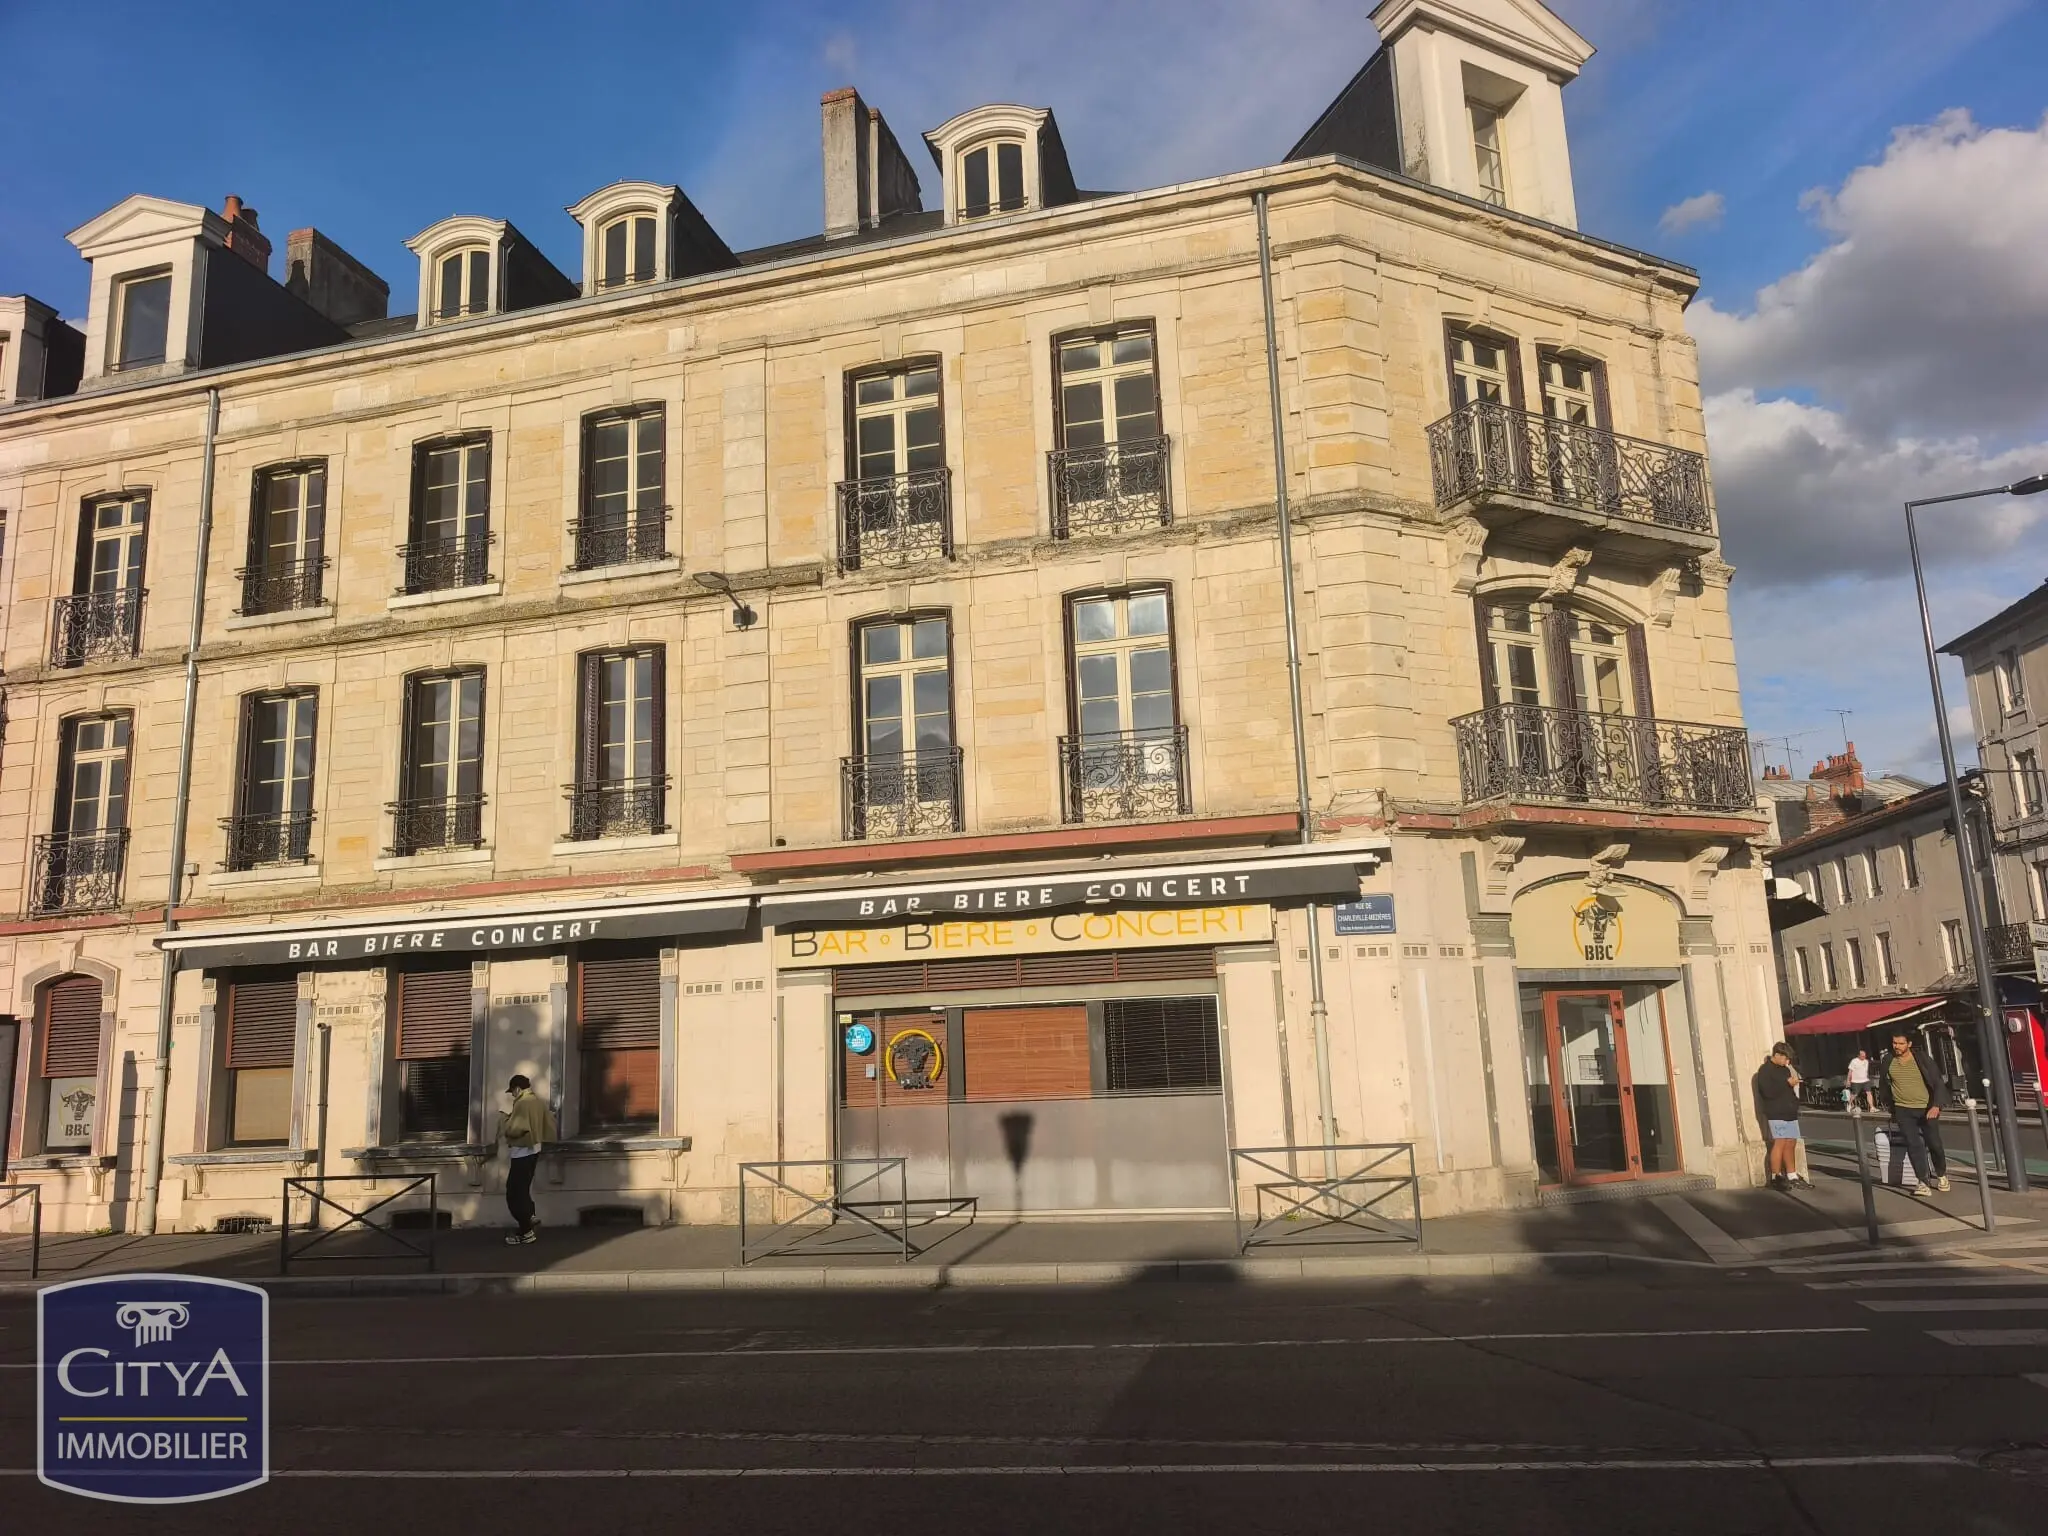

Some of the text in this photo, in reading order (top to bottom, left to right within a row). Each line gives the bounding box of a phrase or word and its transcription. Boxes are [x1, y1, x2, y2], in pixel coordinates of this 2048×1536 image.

[859, 875, 1250, 915] BAR BIERE CONCERT
[288, 919, 602, 959] BAR BIERE CONCERT
[791, 905, 1255, 958] BAR BIERE CONCERT
[1584, 944, 1614, 961] BBC
[65, 1123, 90, 1136] BBC
